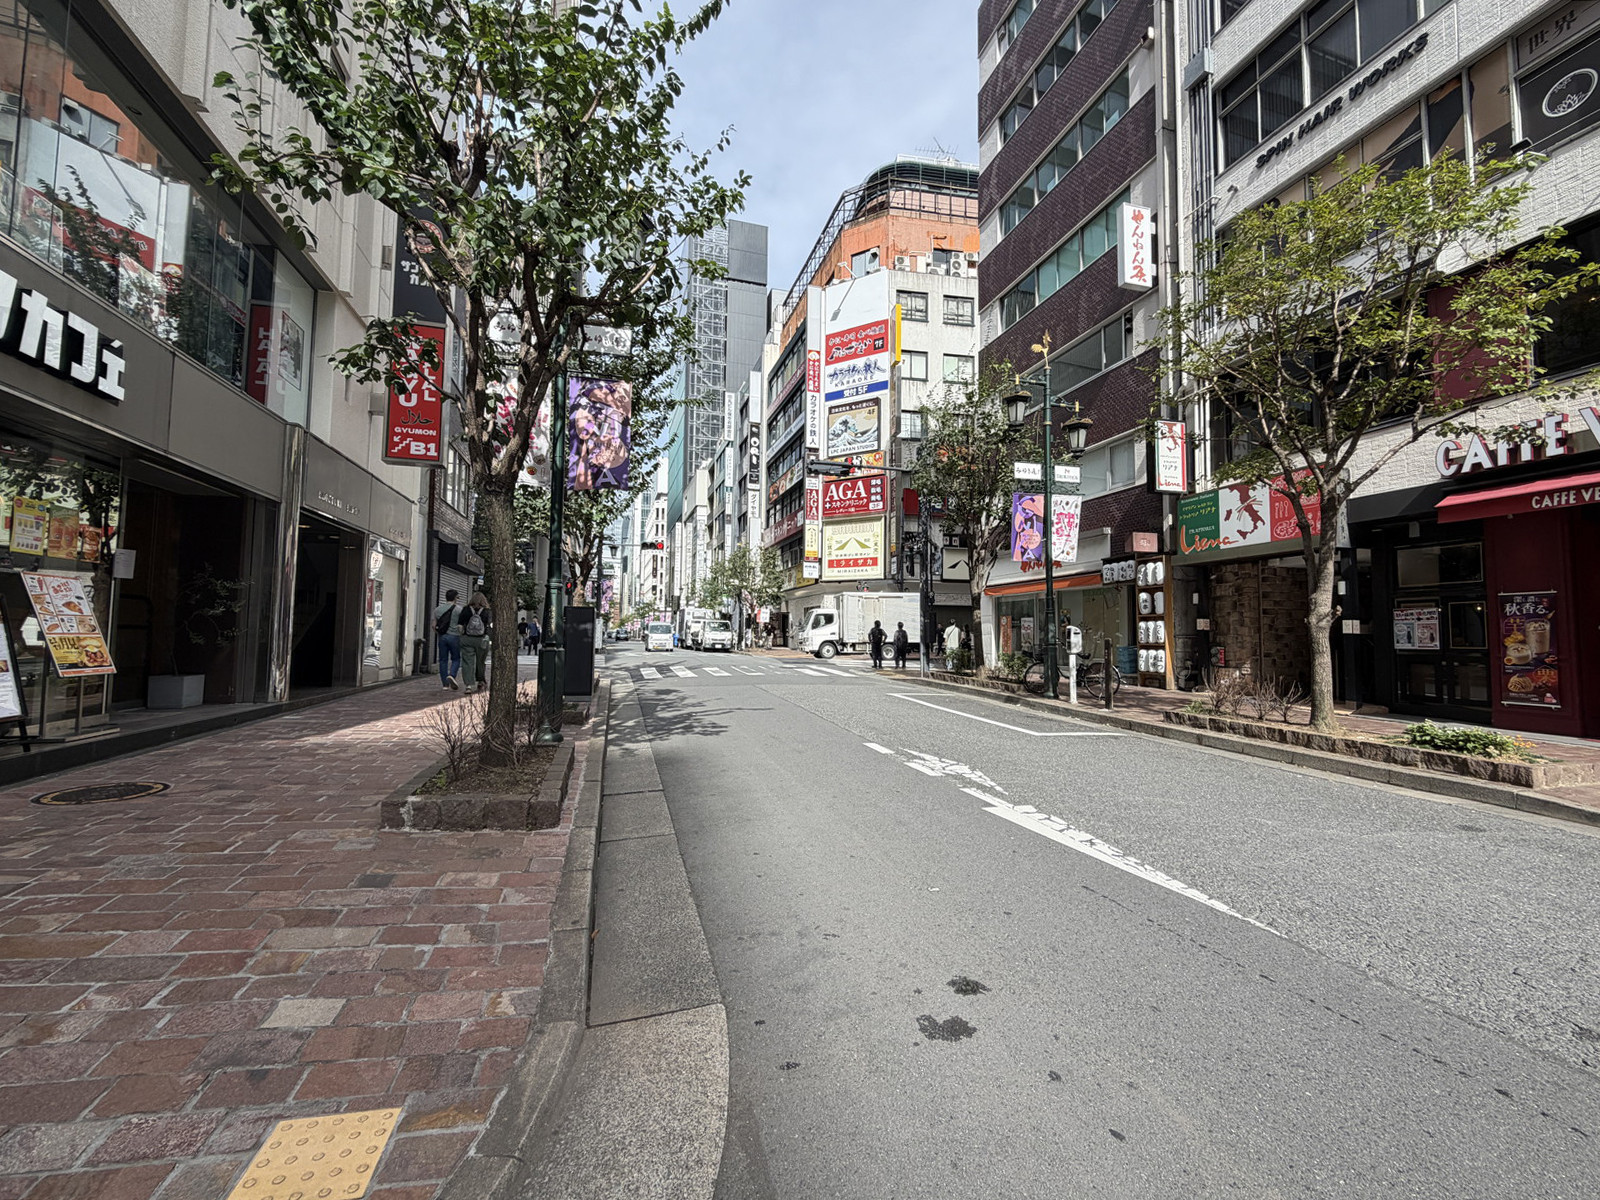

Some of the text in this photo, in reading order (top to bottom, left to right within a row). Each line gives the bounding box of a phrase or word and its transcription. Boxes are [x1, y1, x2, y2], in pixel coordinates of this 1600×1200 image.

[1528, 9, 1578, 54] 世界
[1255, 32, 1429, 168] SPIN HAIR WORKS
[1130, 208, 1147, 283] せんねん灸
[834, 375, 873, 387] KARAOKE
[843, 385, 868, 398] 受付 5F
[809, 394, 818, 446] カラオケの鉄人
[394, 426, 437, 436] GYUMON
[409, 442, 438, 457] B1
[840, 445, 856, 453] JAPAN
[857, 443, 876, 451] STUDIO
[825, 480, 868, 501] AGA
[810, 490, 818, 516] AGA
[831, 499, 867, 508] スキンクリニック
[1531, 490, 1576, 509] CAFFE
[833, 559, 873, 567] ミライザカ
